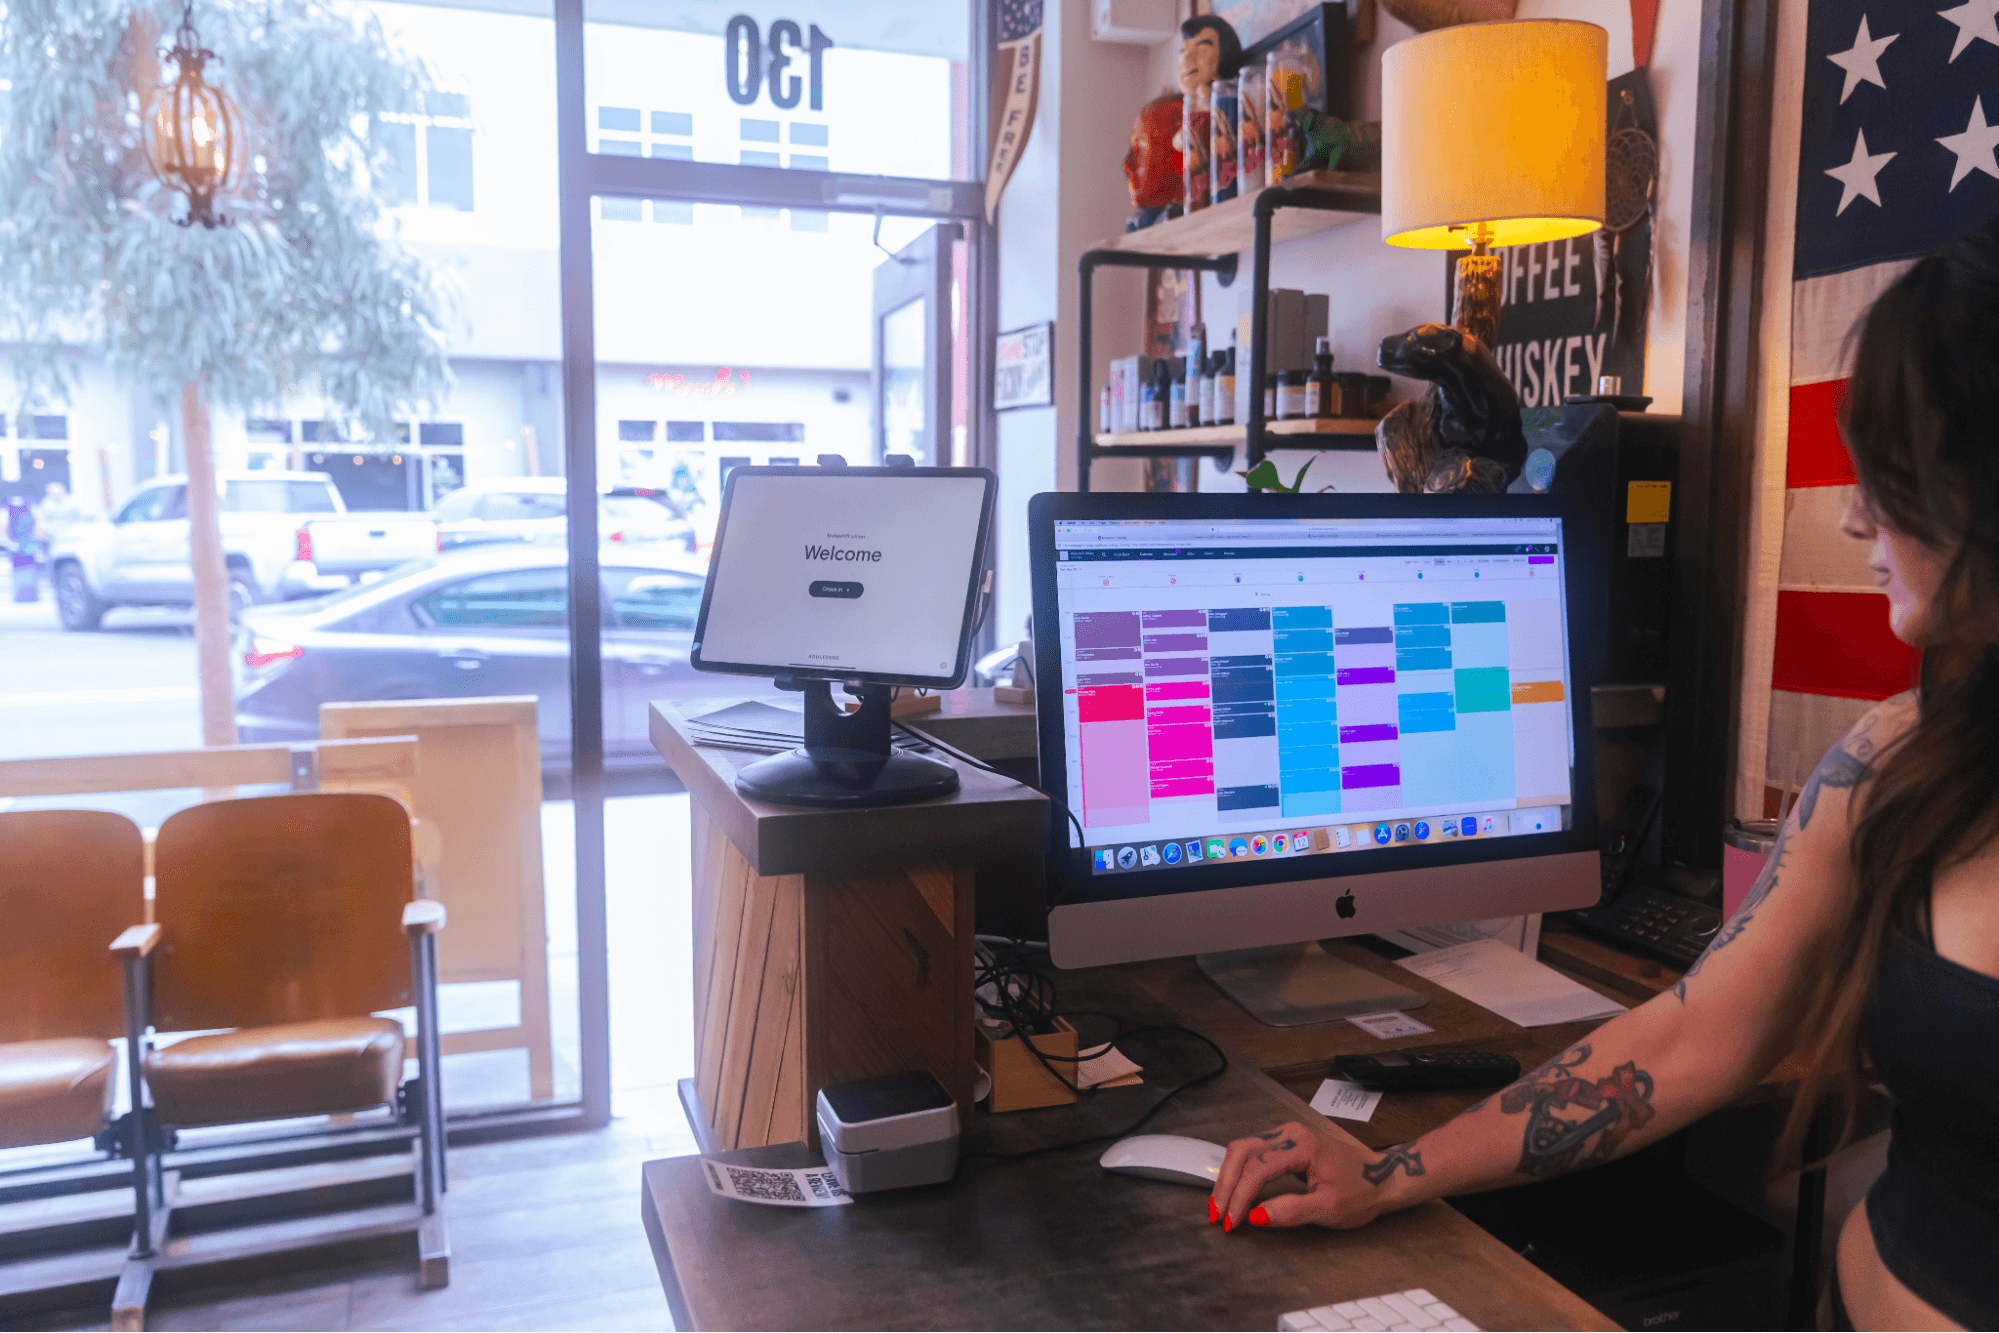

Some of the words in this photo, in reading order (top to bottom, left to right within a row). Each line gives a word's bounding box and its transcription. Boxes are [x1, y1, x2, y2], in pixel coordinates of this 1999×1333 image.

[1486, 237, 1581, 307] OFFEE
[1490, 333, 1607, 407] HISKEY
[804, 544, 882, 562] Welcome
[1643, 1309, 1681, 1328] brother
